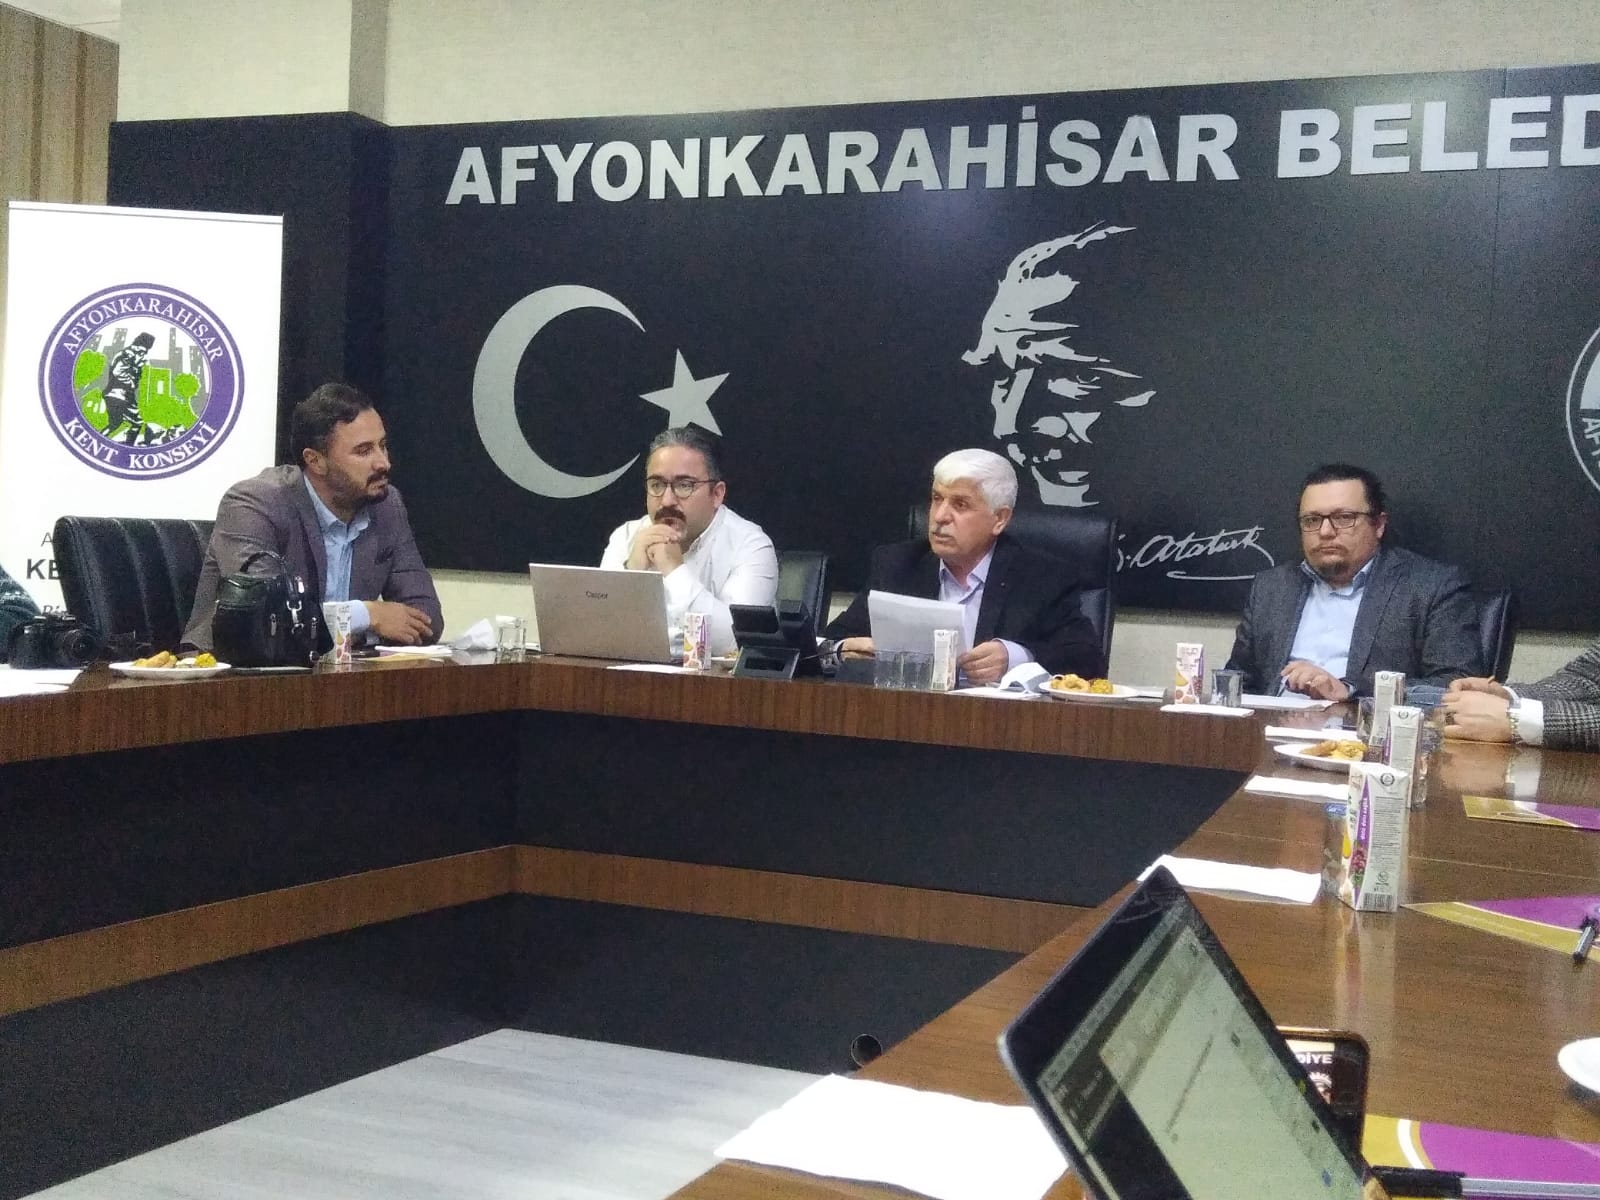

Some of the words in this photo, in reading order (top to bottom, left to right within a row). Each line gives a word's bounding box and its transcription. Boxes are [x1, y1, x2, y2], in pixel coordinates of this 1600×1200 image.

[446, 105, 1239, 205] AFYONKARAHİSAR
[63, 297, 223, 361] AFYONKARAHİSAR
[64, 417, 118, 462] KENT
[129, 421, 217, 469] KONSEYİ
[26, 558, 61, 580] KE
